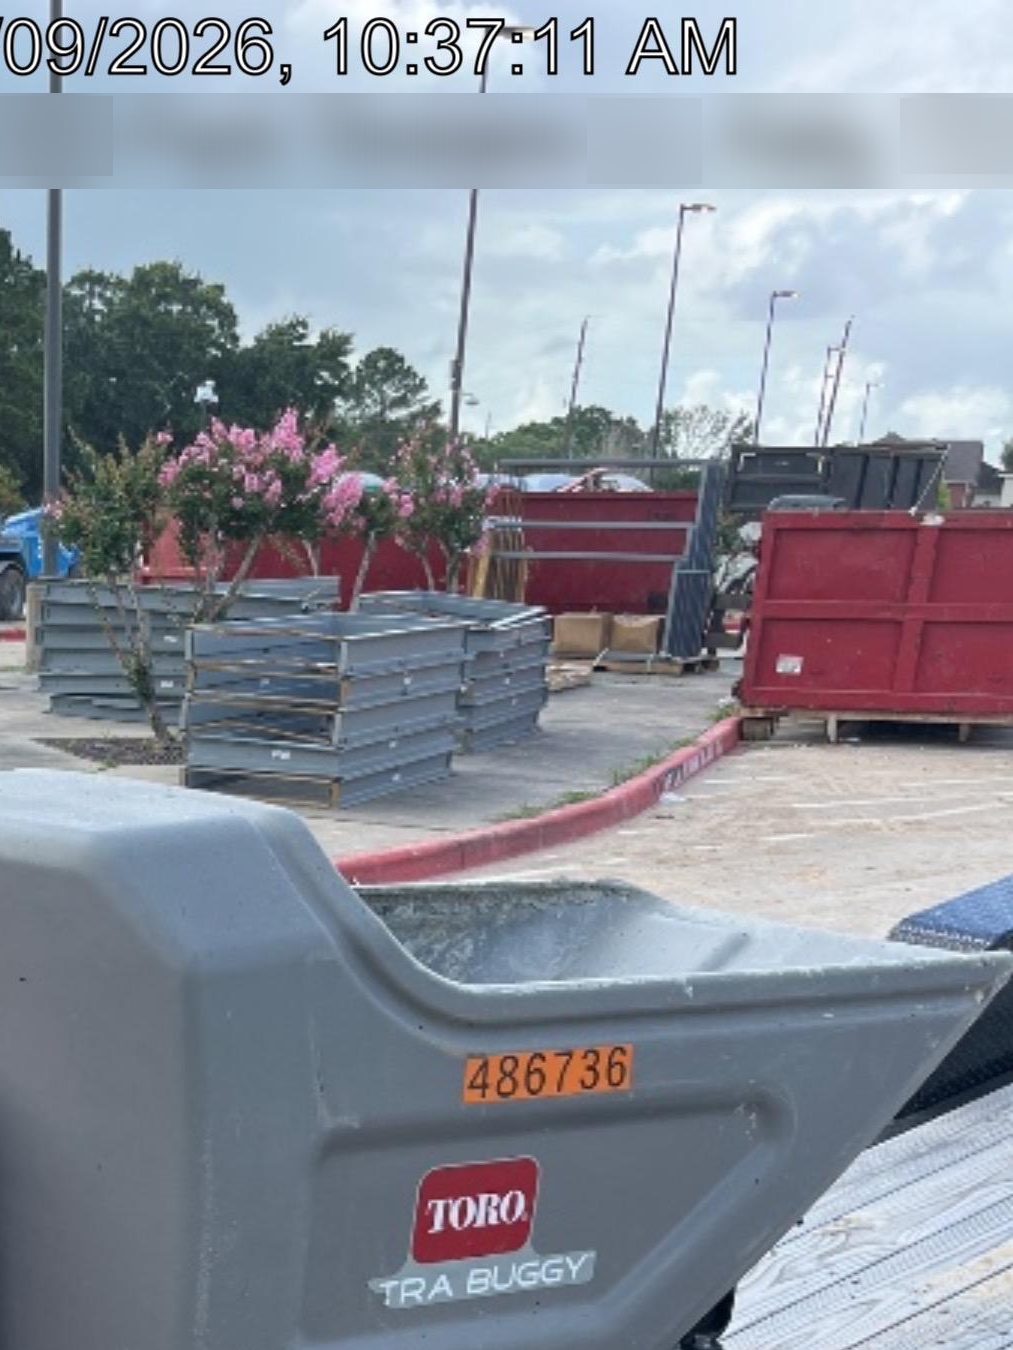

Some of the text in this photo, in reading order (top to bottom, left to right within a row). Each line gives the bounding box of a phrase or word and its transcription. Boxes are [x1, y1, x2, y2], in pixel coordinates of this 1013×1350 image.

[467, 1046, 627, 1098] 486736
[426, 1190, 527, 1234] TORO
[466, 1251, 590, 1295] BUGGY
